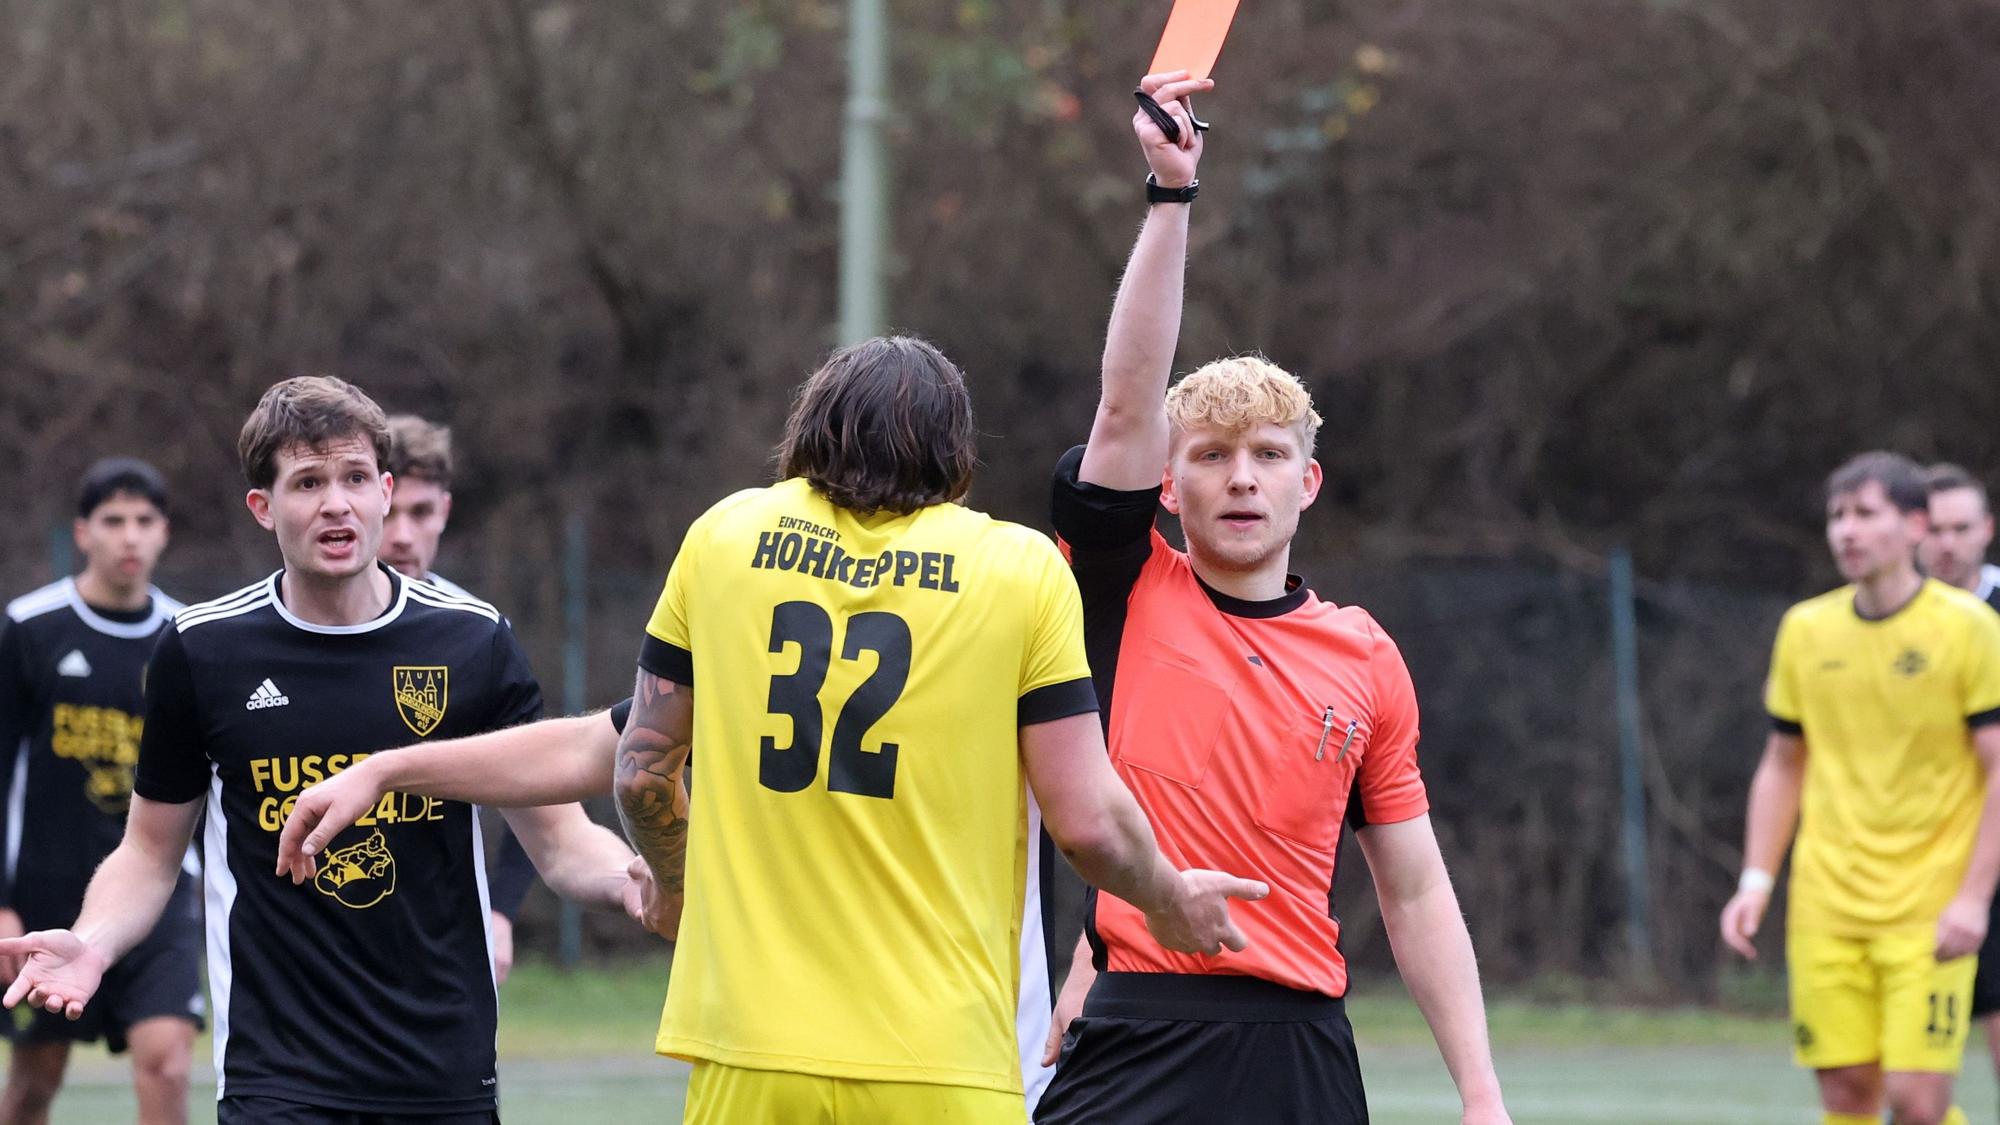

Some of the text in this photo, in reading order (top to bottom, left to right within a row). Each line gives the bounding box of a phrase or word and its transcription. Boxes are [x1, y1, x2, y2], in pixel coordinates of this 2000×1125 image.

[778, 515, 842, 542] EINTRACHT
[751, 531, 960, 593] HOHKEPPEL
[246, 695, 290, 711] adidas
[758, 600, 912, 800] 32
[250, 752, 377, 793] FUSS
